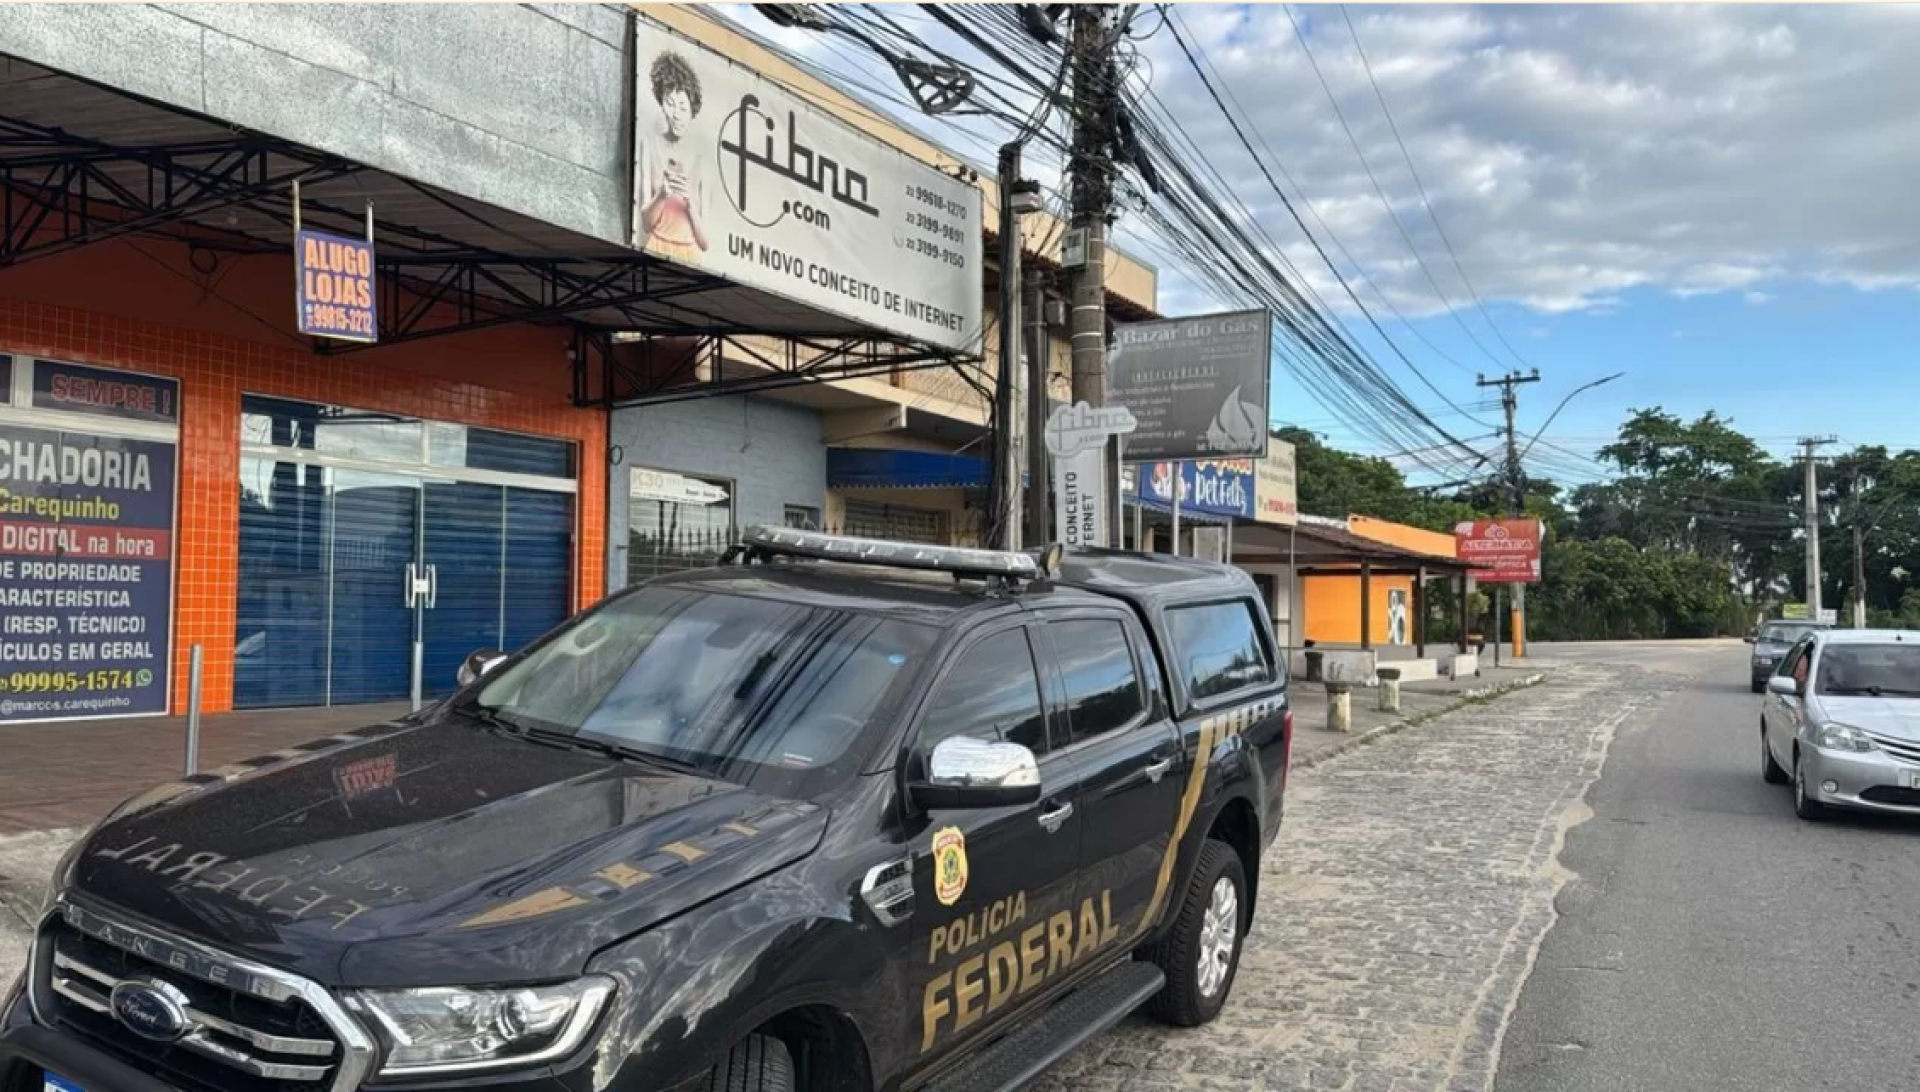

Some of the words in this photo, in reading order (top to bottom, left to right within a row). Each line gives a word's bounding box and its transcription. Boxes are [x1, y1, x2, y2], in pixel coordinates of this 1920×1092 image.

[304, 238, 371, 278] ALUGO
[305, 270, 371, 308] LOJAS
[728, 233, 753, 262] UM
[759, 247, 804, 279] NOVO
[808, 264, 880, 306] CONCEITO
[884, 290, 901, 313] DE
[905, 298, 965, 334] INTERNET
[1123, 326, 1180, 344] Bazar
[1187, 323, 1211, 338] do
[51, 373, 157, 414] SEMPRE
[0, 439, 152, 491] CHADORIA
[0, 488, 120, 522] Carequinho
[1065, 472, 1077, 545] CONCEITO
[3, 525, 81, 553] DIGITAL
[87, 535, 110, 553] na
[116, 532, 154, 556] hora
[0, 560, 14, 579] E
[21, 562, 142, 582] PROPRIEDADE
[68, 642, 95, 661] EM
[101, 642, 153, 660] GERAL
[11, 670, 132, 693] 99995-1574
[921, 888, 1120, 1055] FEDERAL
